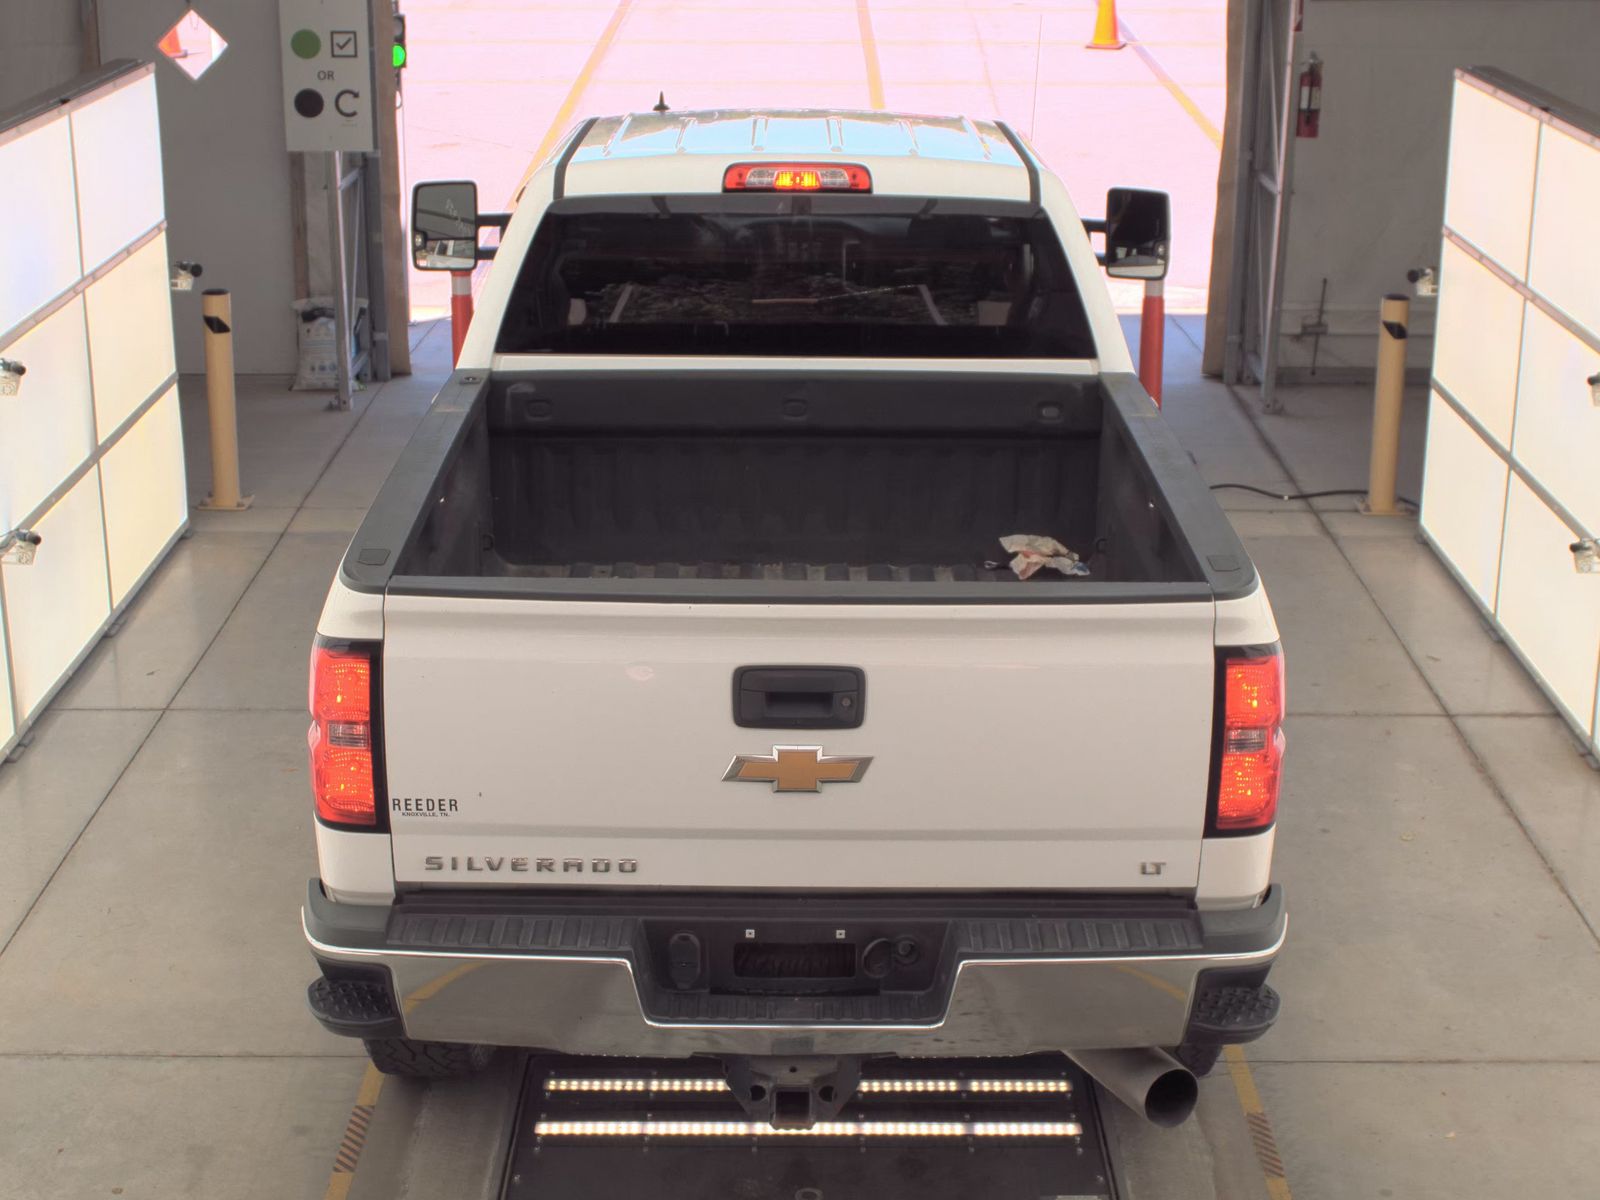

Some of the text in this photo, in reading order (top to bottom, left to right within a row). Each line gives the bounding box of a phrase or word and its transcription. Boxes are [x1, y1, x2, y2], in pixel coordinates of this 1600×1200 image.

[317, 70, 335, 81] OR
[392, 798, 458, 811] REEDER
[425, 856, 638, 873] SILVERADO
[1140, 862, 1167, 875] LT
